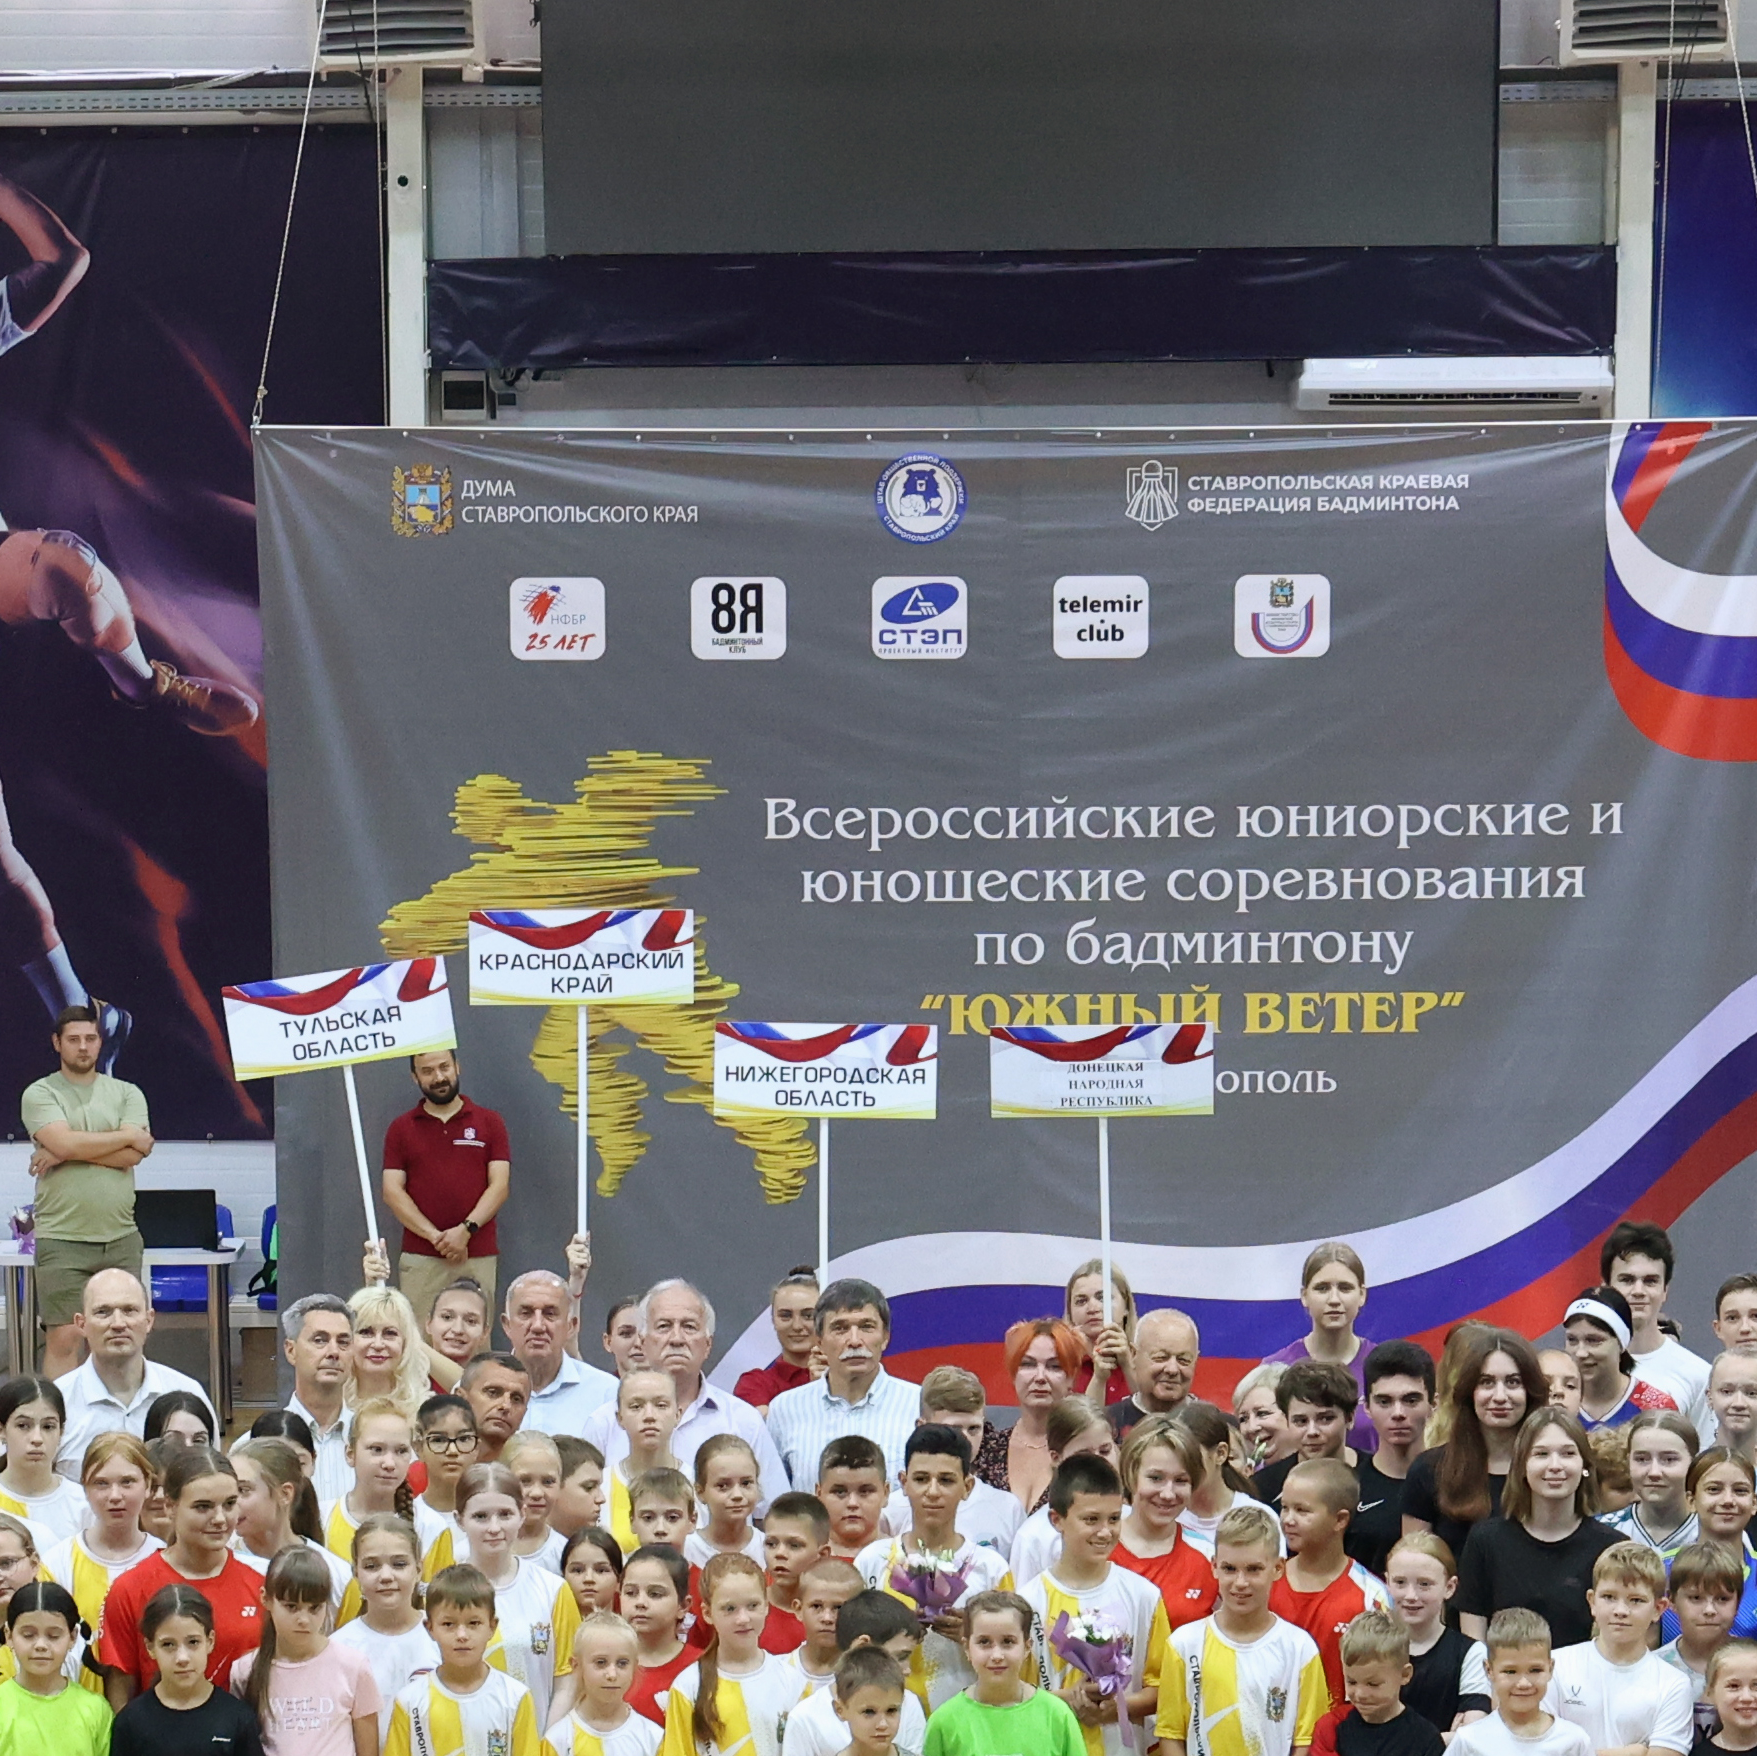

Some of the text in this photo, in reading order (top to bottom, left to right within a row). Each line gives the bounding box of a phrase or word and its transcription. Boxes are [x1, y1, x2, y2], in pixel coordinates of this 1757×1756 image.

[460, 480, 516, 500] ДУМА
[1187, 473, 1470, 491] СТАВРОПОЛЬСКАЯ КРАЕВАЯ
[461, 505, 699, 523] СТАВРОПОЛЬСКОГО КРАЯ
[1187, 494, 1460, 515] ФЕДЕРАЦИЯ БАДМИНТОНА
[710, 582, 764, 635] 8Я
[1058, 594, 1143, 614] telemir
[550, 613, 586, 625] НФБР
[878, 628, 963, 645] СТЭП
[1077, 619, 1125, 642] club
[525, 633, 596, 651] 25 ЛЕТ
[764, 795, 1625, 851] Всероссийские юниорские и
[800, 863, 1587, 912] юношеские соревнования
[974, 918, 1413, 973] по бадминтону
[479, 950, 684, 971] КРАСНОДАРСКИЙ
[550, 973, 613, 994] КРАЙ
[279, 1005, 402, 1040] ТУЛЬСКАЯ
[292, 1031, 396, 1062] ОБЛАСТЬ
[725, 1066, 926, 1085] НИЖЕГОРОДСКАЯ
[1067, 1062, 1144, 1074] ДОНЕЦКАЯ
[1068, 1079, 1144, 1090] НАРОДНАЯ
[774, 1090, 876, 1107] ОБЛАСТЬ
[1060, 1095, 1153, 1107] РЕСПУБЛИКА
[268, 1697, 335, 1716] WILD
